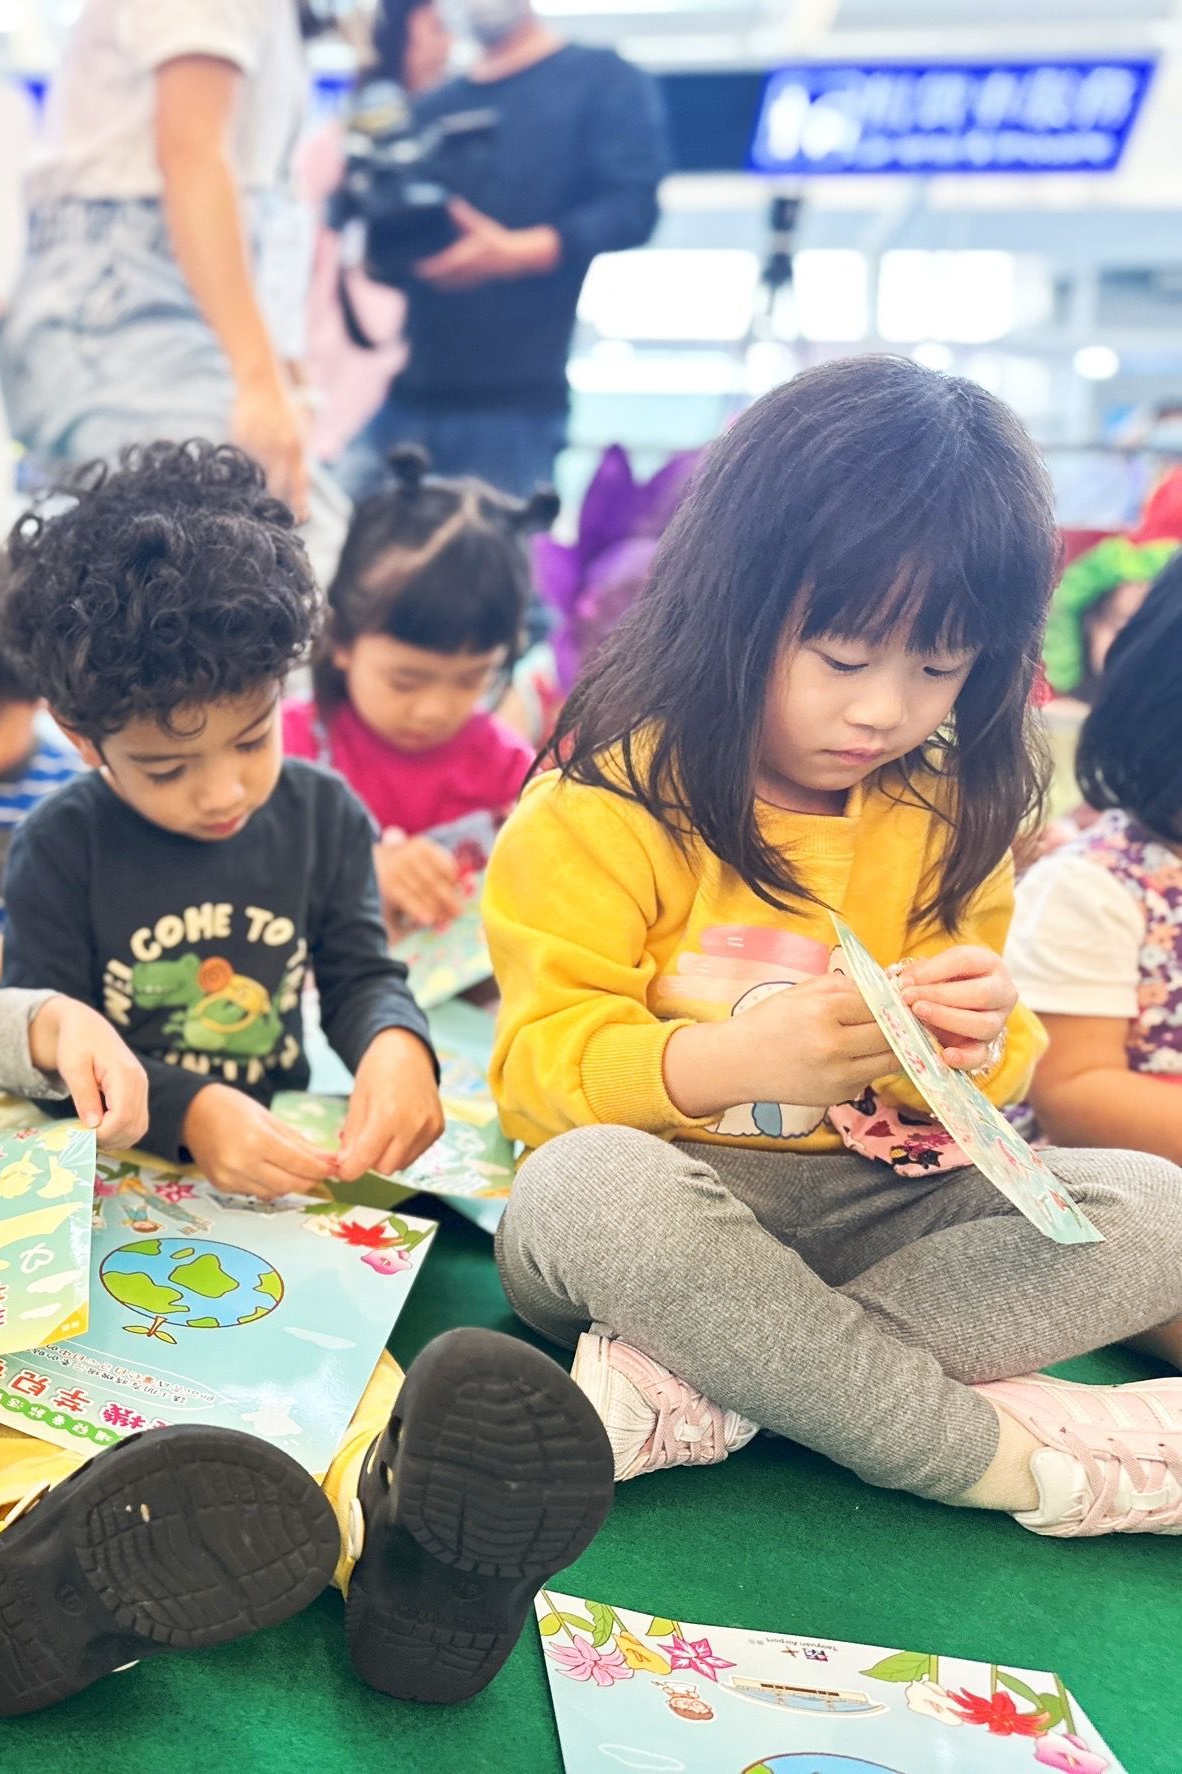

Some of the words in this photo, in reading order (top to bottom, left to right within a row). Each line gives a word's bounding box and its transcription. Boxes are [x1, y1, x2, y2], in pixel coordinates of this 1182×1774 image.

[244, 905, 295, 947] TO
[765, 1637, 798, 1647] Airport
[799, 1641, 838, 1652] Taoyuan
